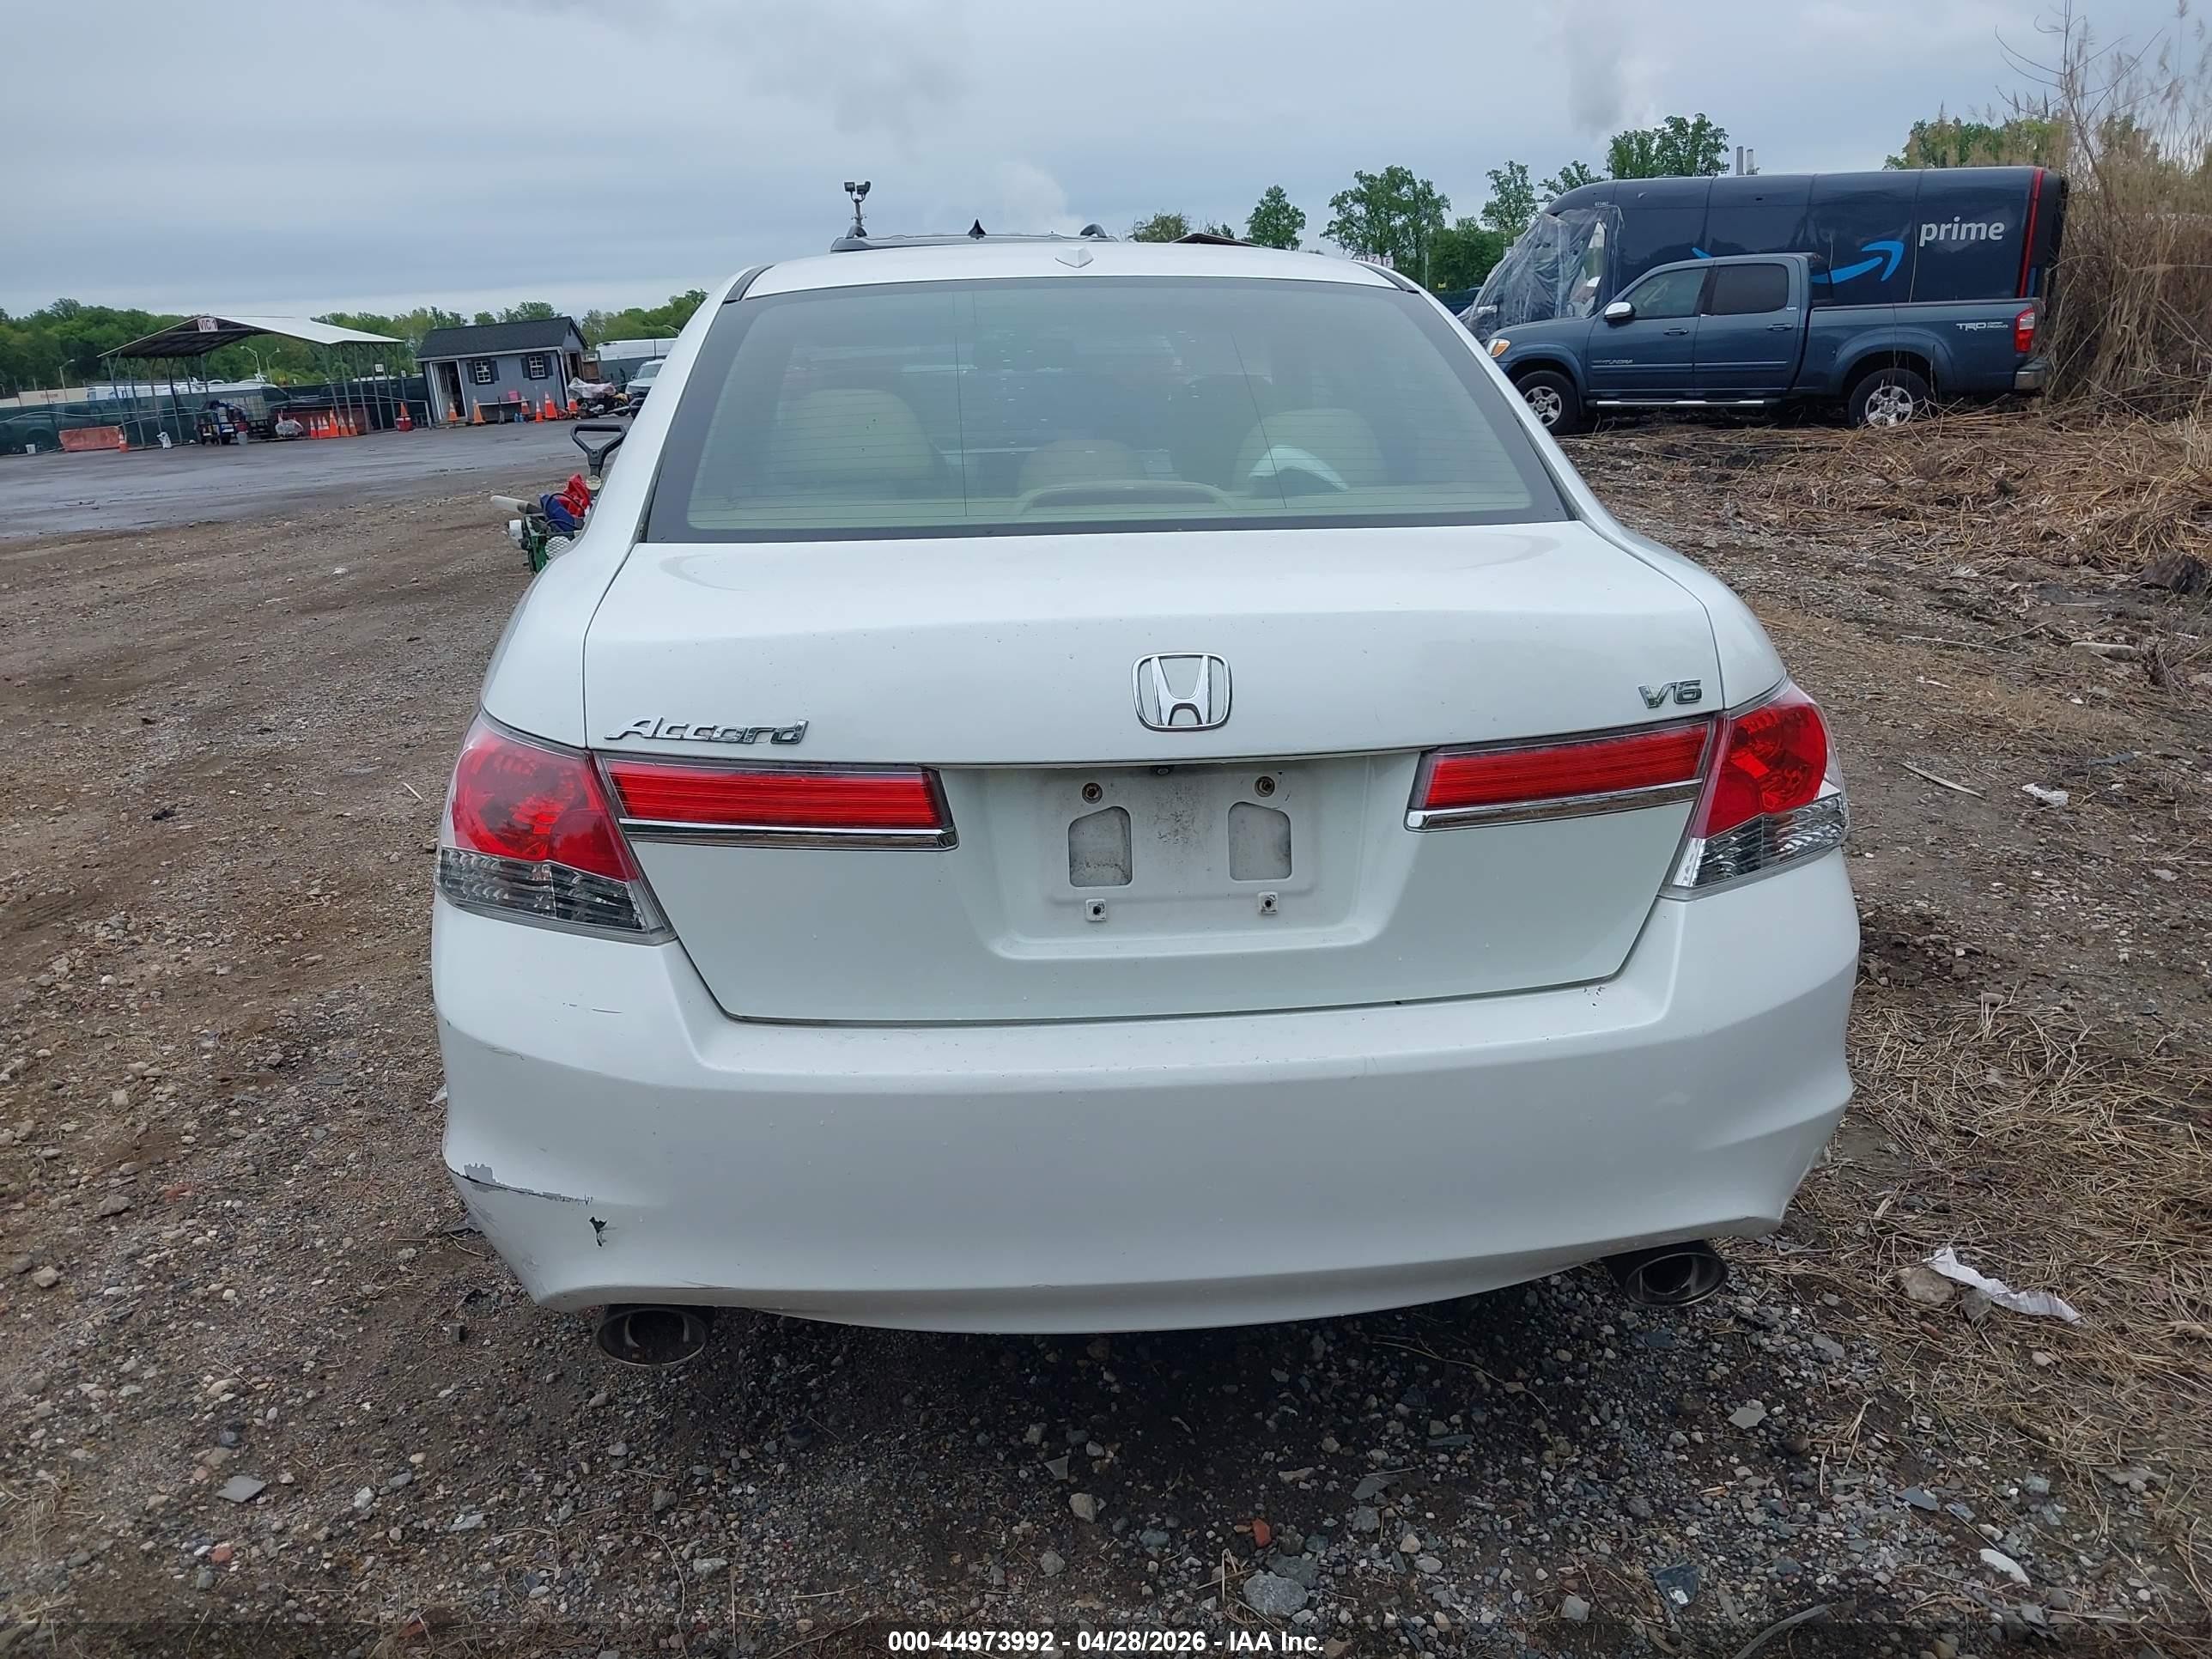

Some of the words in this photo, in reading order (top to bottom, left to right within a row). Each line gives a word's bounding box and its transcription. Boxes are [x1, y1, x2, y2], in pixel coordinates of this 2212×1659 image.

[1918, 216, 2005, 247] prime
[198, 319, 211, 331] VIC
[1955, 322, 1987, 331] TRD
[1638, 679, 1703, 709] V6
[604, 716, 810, 745] Accord
